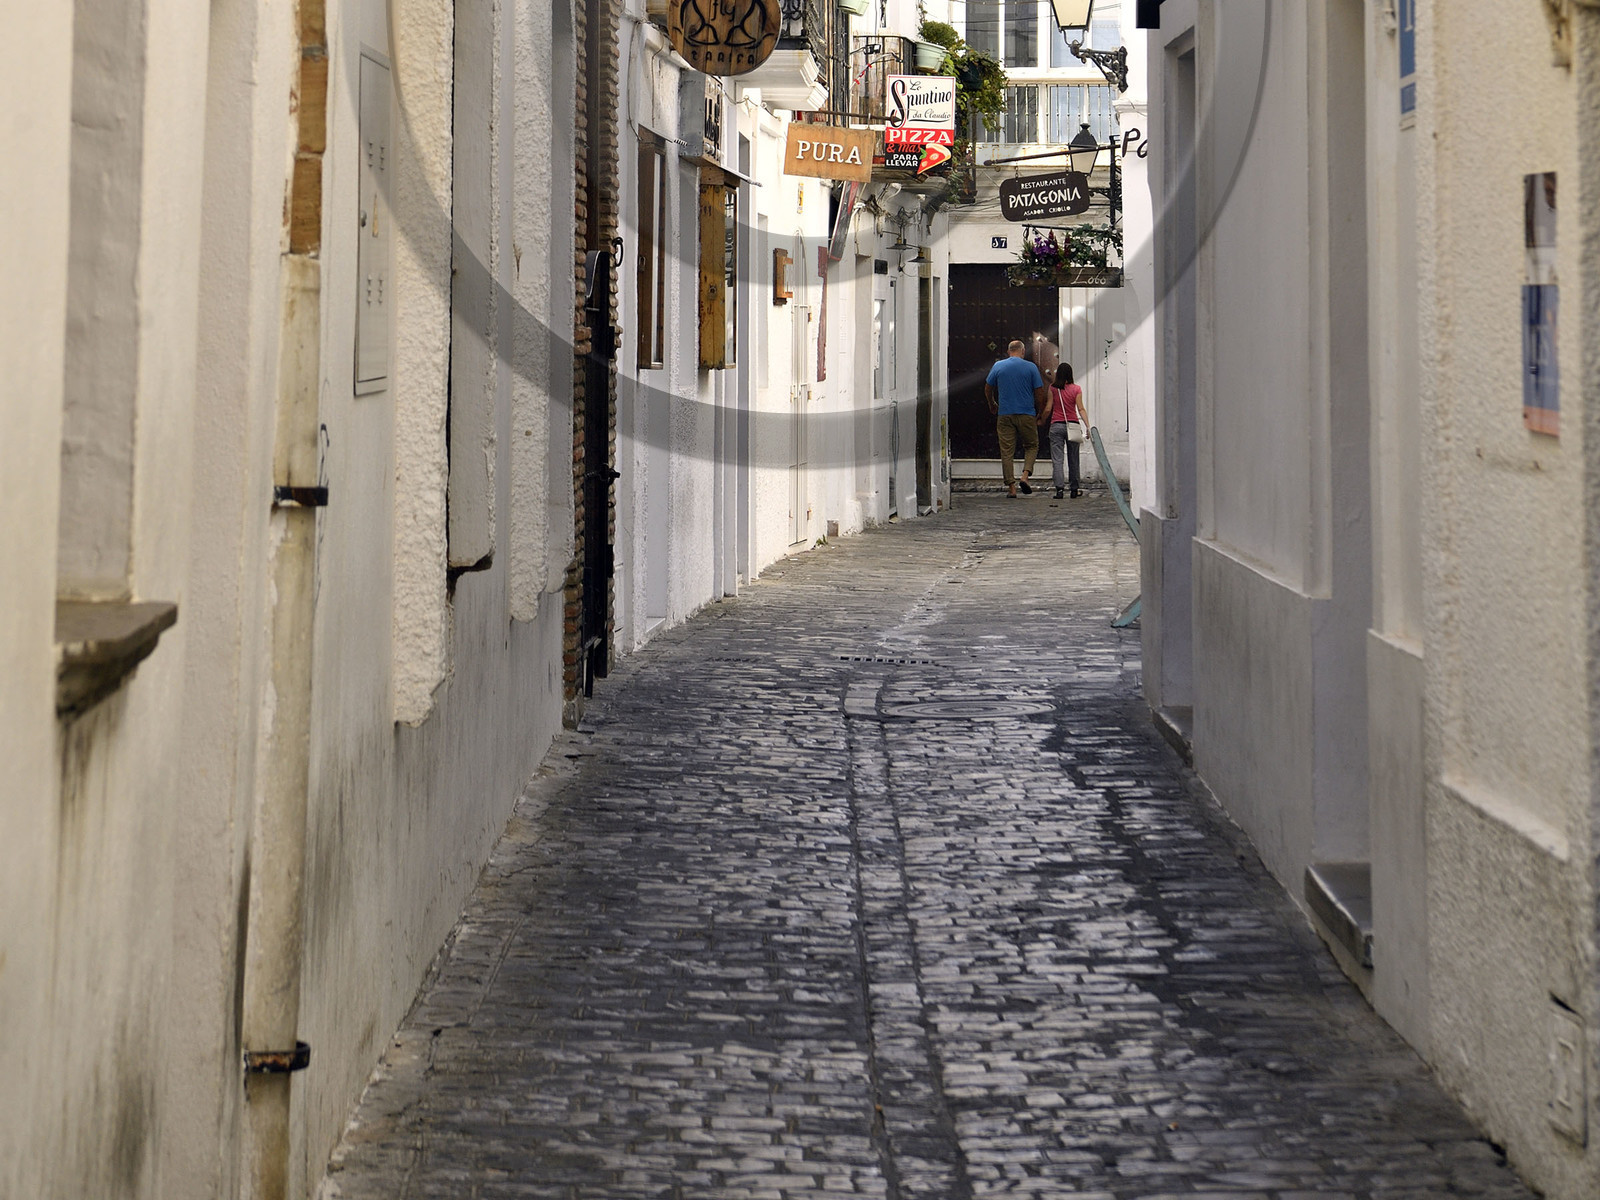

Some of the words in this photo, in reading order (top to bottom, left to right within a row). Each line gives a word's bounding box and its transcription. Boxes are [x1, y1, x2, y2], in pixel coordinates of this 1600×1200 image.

[890, 80, 952, 128] Spuntino
[924, 108, 951, 119] Claudio
[889, 129, 952, 144] PIZZA
[795, 140, 863, 166] PURA
[886, 143, 896, 153] &
[893, 153, 919, 161] PARA
[1020, 178, 1067, 190] RESTAURANTE
[1009, 186, 1081, 208] PATAGONIA
[1023, 208, 1045, 216] ASADOR
[1048, 205, 1071, 213] CRIOLLO
